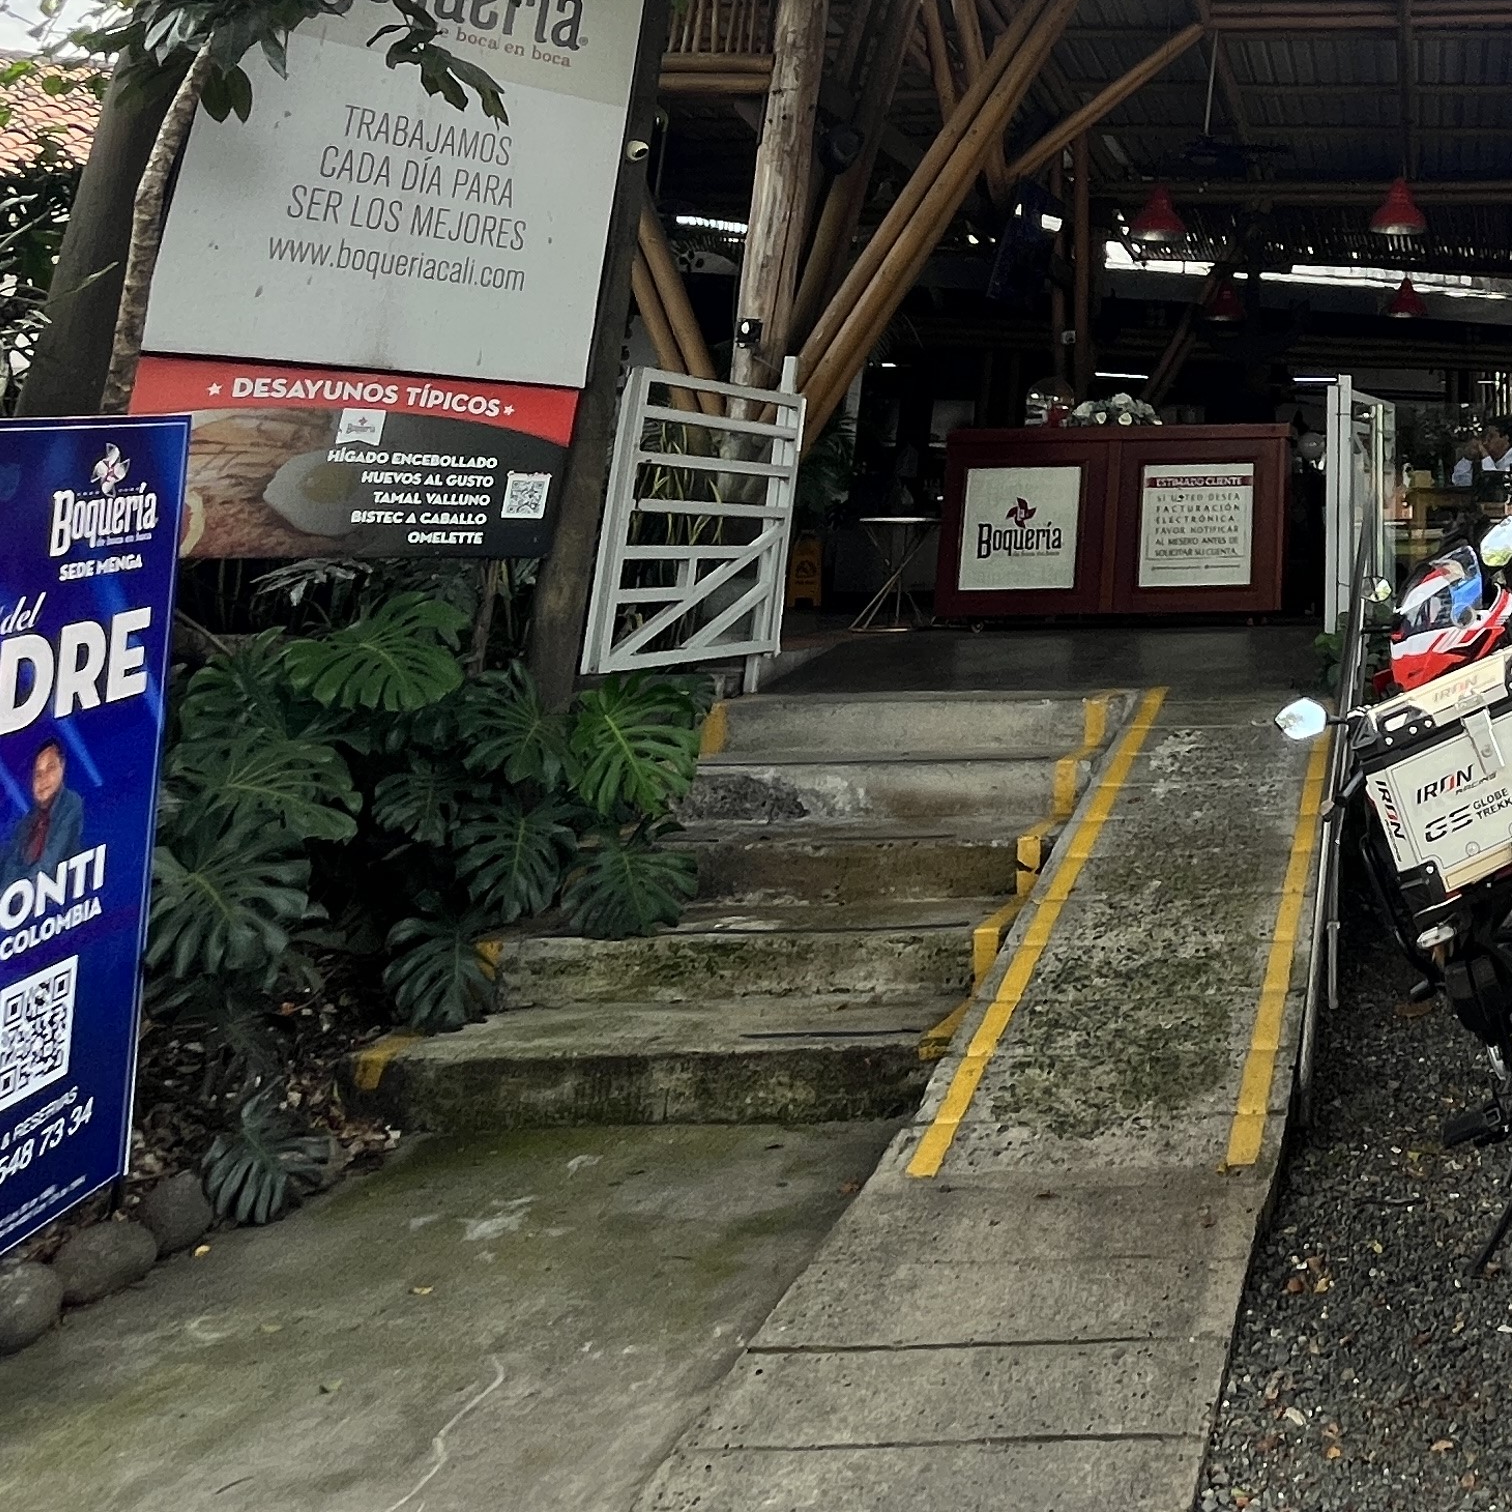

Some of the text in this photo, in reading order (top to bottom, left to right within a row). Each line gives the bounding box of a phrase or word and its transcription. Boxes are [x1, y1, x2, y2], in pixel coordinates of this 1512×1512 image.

[457, 26, 498, 51] boca
[504, 40, 525, 58] en
[531, 46, 572, 68] boca
[344, 104, 512, 166] TRABAJAMOS
[320, 145, 513, 209] CADA DÍA PARA
[287, 184, 527, 251] SER LOS MEJORES
[268, 236, 526, 292] www.boqueriacali.com
[231, 377, 501, 418] DESAYUNOS TÍPICOS
[327, 447, 498, 469] HÍGADO ENCEBOLLADO
[361, 470, 494, 488] HUEVOS AL GUSTO
[373, 491, 491, 506] TAMAL VALLUNO
[49, 482, 158, 558] Boquería
[350, 510, 488, 525] BISTEC A CABALLO
[1156, 503, 1240, 513] FACTURACIÓN
[407, 531, 484, 545] OMELETTE
[977, 521, 1062, 560] Boquería
[1155, 525, 1239, 535] FAVOR NOTIFICAR
[59, 554, 143, 581] SEDE MENGA
[0, 591, 47, 636] del
[1433, 675, 1478, 703] IRON
[1416, 763, 1475, 805] IRON
[1473, 787, 1509, 810] GLOBE
[1375, 780, 1406, 841] IRON
[1424, 803, 1473, 843] GS
[0, 843, 107, 931] ONTI
[0, 896, 102, 961] COLOMBIA
[39, 1117, 65, 1157] 73
[68, 1096, 94, 1136] 34
